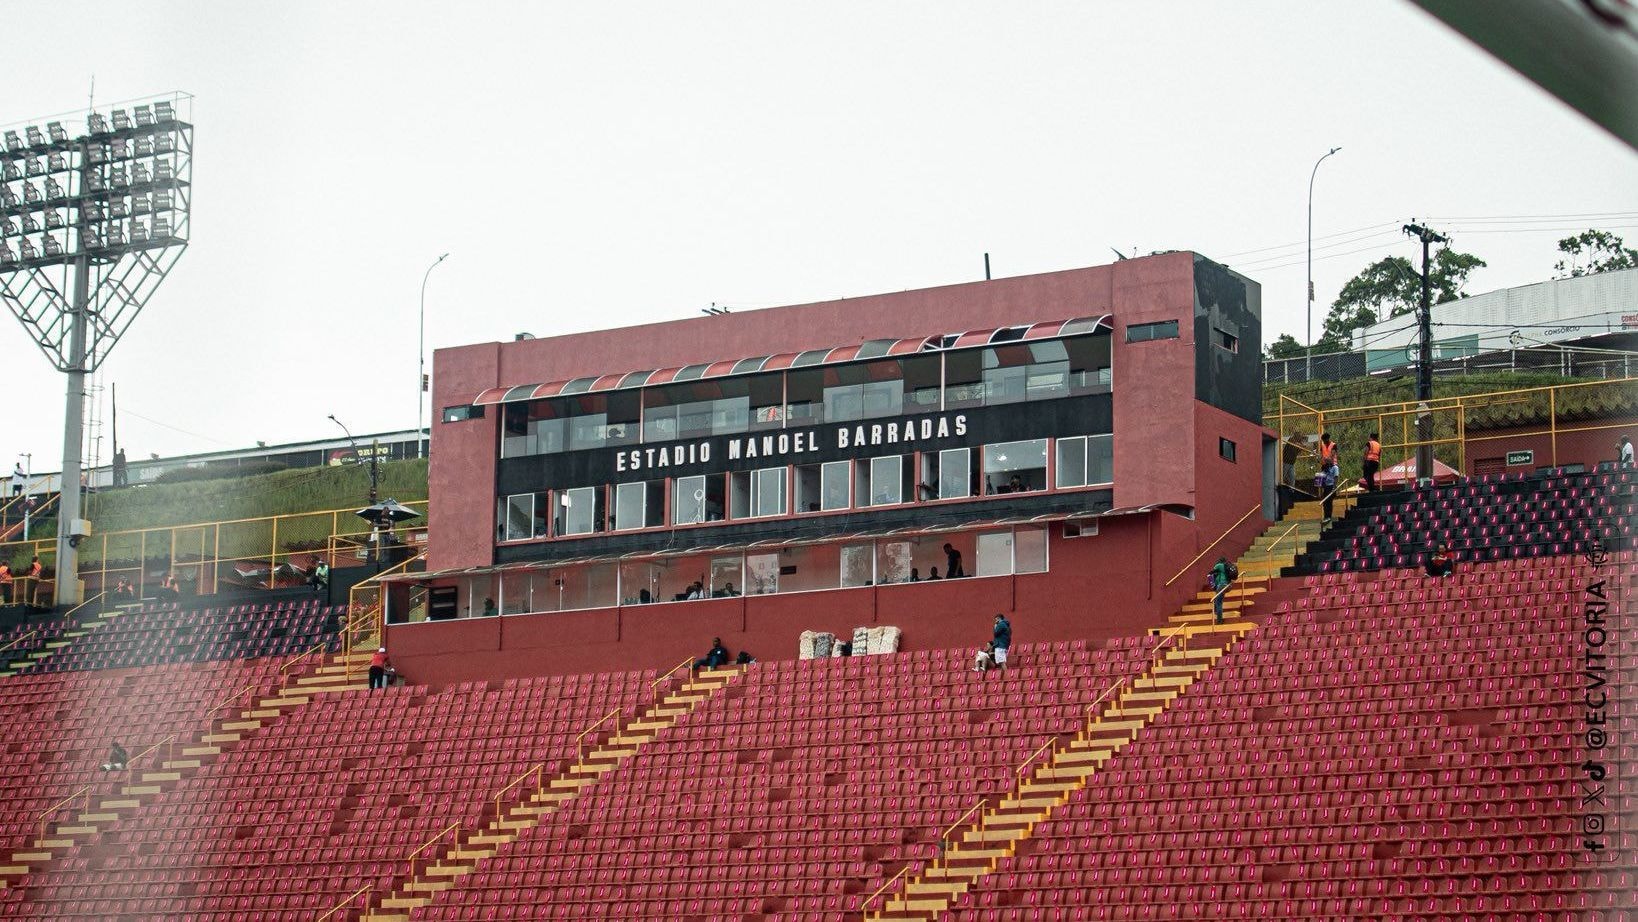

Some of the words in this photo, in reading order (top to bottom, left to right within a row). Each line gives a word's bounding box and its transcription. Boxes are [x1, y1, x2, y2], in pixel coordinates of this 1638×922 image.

[616, 441, 711, 472] ESTADIO
[728, 430, 819, 460] MANOEL
[838, 415, 968, 449] BARRADAS
